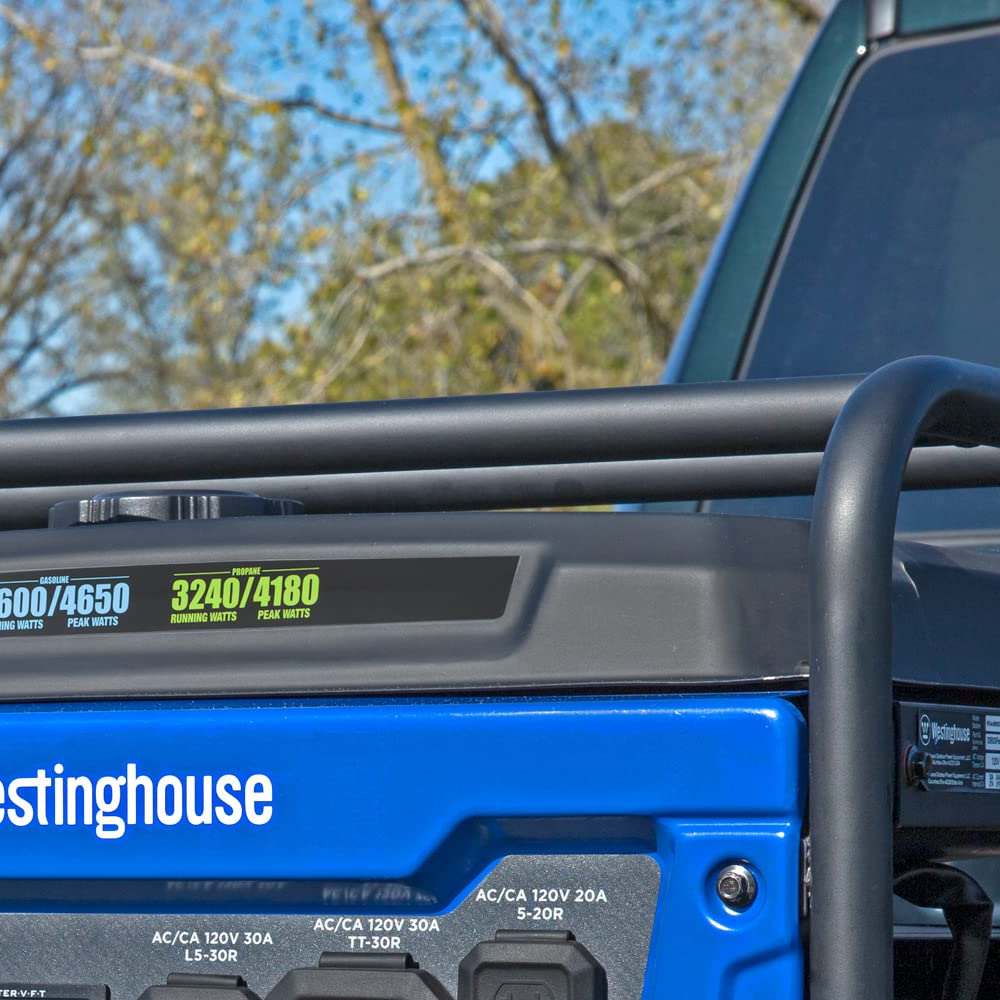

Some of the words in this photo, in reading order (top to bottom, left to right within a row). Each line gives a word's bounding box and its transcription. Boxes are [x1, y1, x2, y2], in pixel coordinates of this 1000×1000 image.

[232, 566, 261, 576] PROPANE
[40, 575, 69, 585] GASOLINE
[171, 573, 320, 611] 3240/4180
[170, 612, 207, 624] RUNNING
[209, 611, 237, 622] WATTS
[257, 609, 279, 620] PEAK
[281, 607, 311, 619] WATTS
[16, 619, 43, 631] WATTS
[67, 617, 88, 628] PEAK
[90, 615, 118, 627] WATTS
[931, 722, 971, 744] Westinghouse
[475, 888, 529, 902] AC/CA
[532, 888, 572, 902] 120V
[575, 889, 608, 903] 20A
[516, 906, 564, 921] 5-20R
[313, 917, 365, 931] AC/CA
[368, 917, 405, 932] 120V
[407, 918, 440, 932] 30A
[152, 931, 201, 946] AC/CA
[204, 931, 240, 945] 120V
[243, 931, 273, 945] 30A
[348, 935, 401, 949] TT-30R
[184, 948, 238, 963] L5-30R
